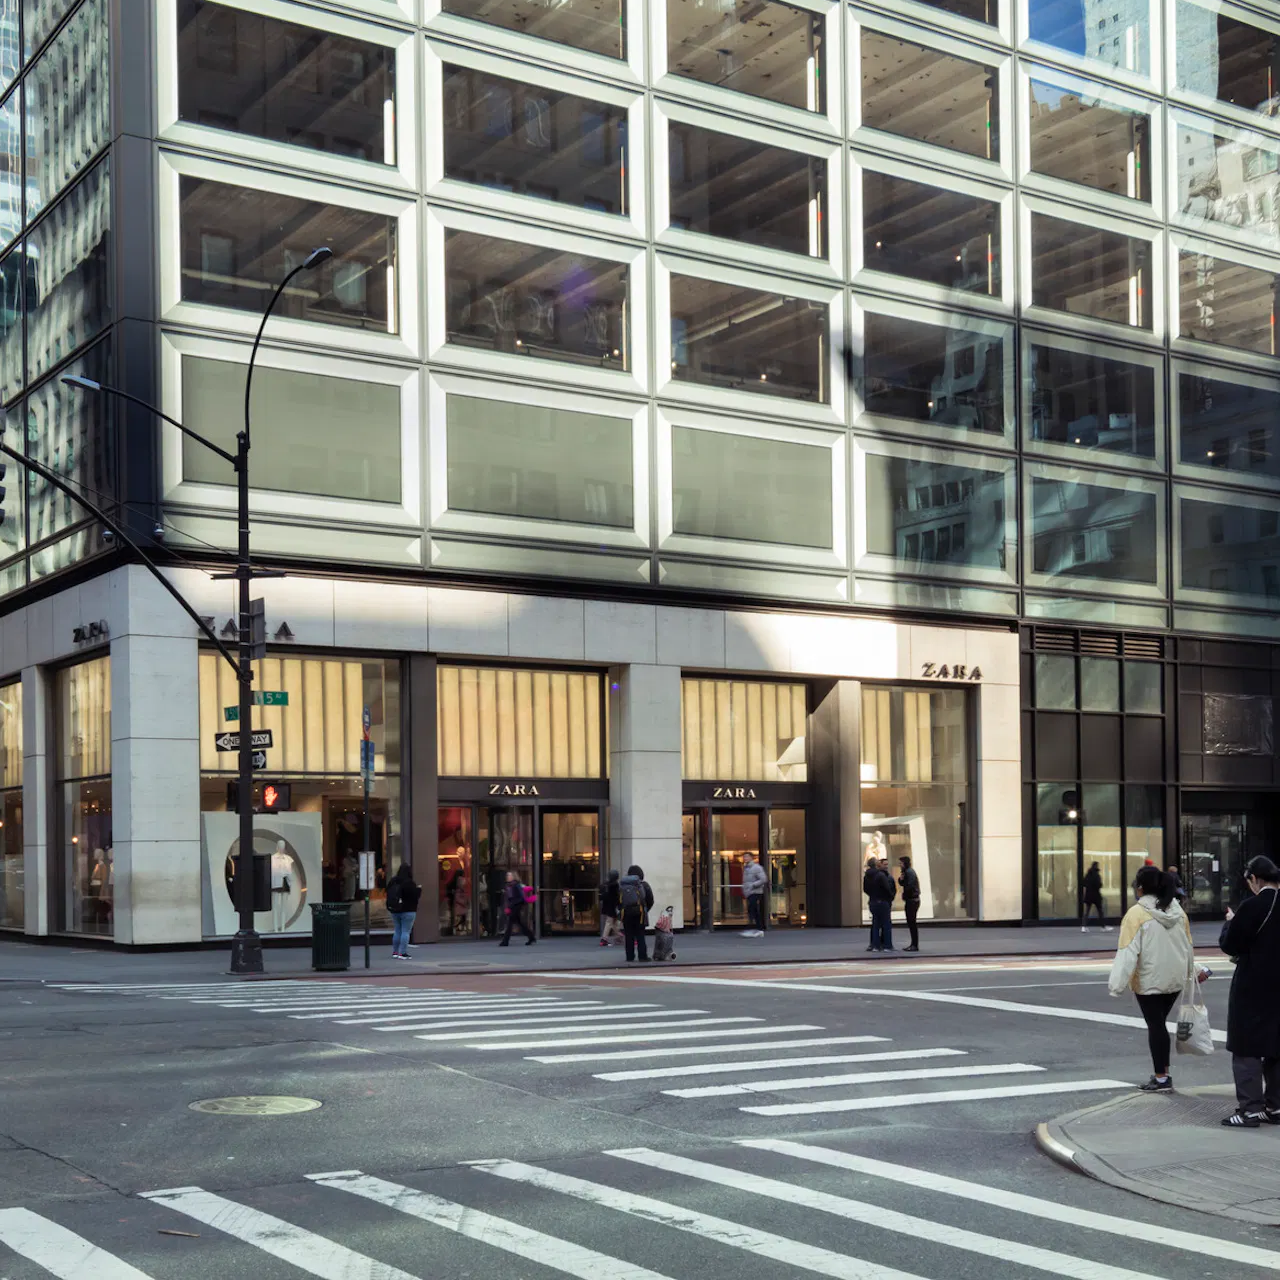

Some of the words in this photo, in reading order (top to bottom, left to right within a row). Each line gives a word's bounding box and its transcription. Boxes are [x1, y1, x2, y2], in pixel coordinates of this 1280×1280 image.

[197, 616, 295, 638] ZAA
[921, 662, 984, 681] ZARA
[266, 692, 274, 705] 5
[489, 783, 540, 796] ZARA
[713, 787, 757, 799] ZARA
